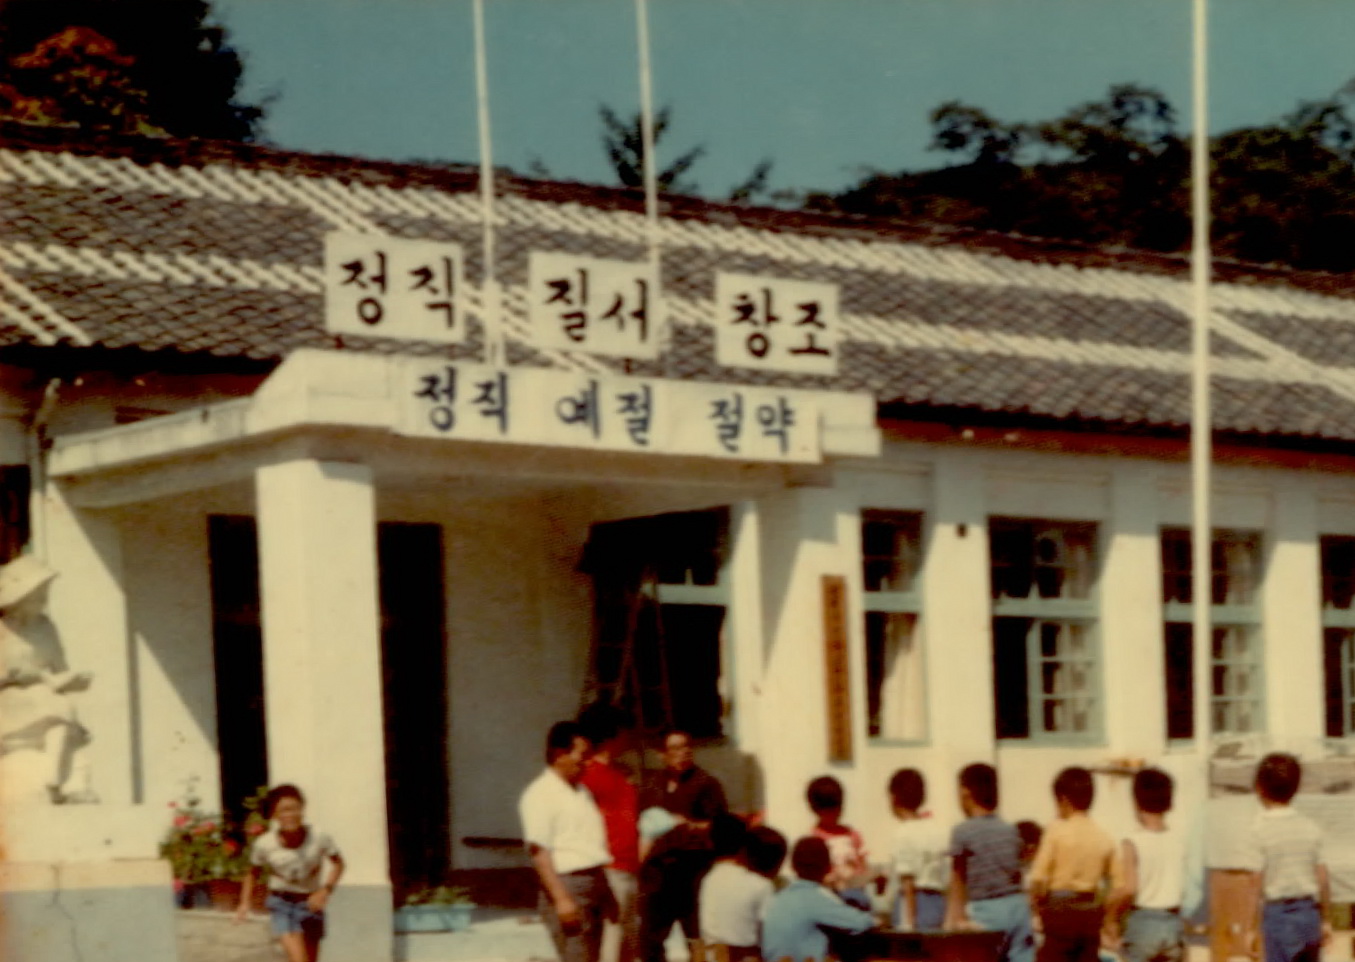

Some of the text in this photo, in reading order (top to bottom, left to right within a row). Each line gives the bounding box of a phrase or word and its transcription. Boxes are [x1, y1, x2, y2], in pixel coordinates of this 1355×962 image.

[339, 251, 832, 360] 정직 질서 창조
[413, 366, 795, 455] 정직 예절 절약
